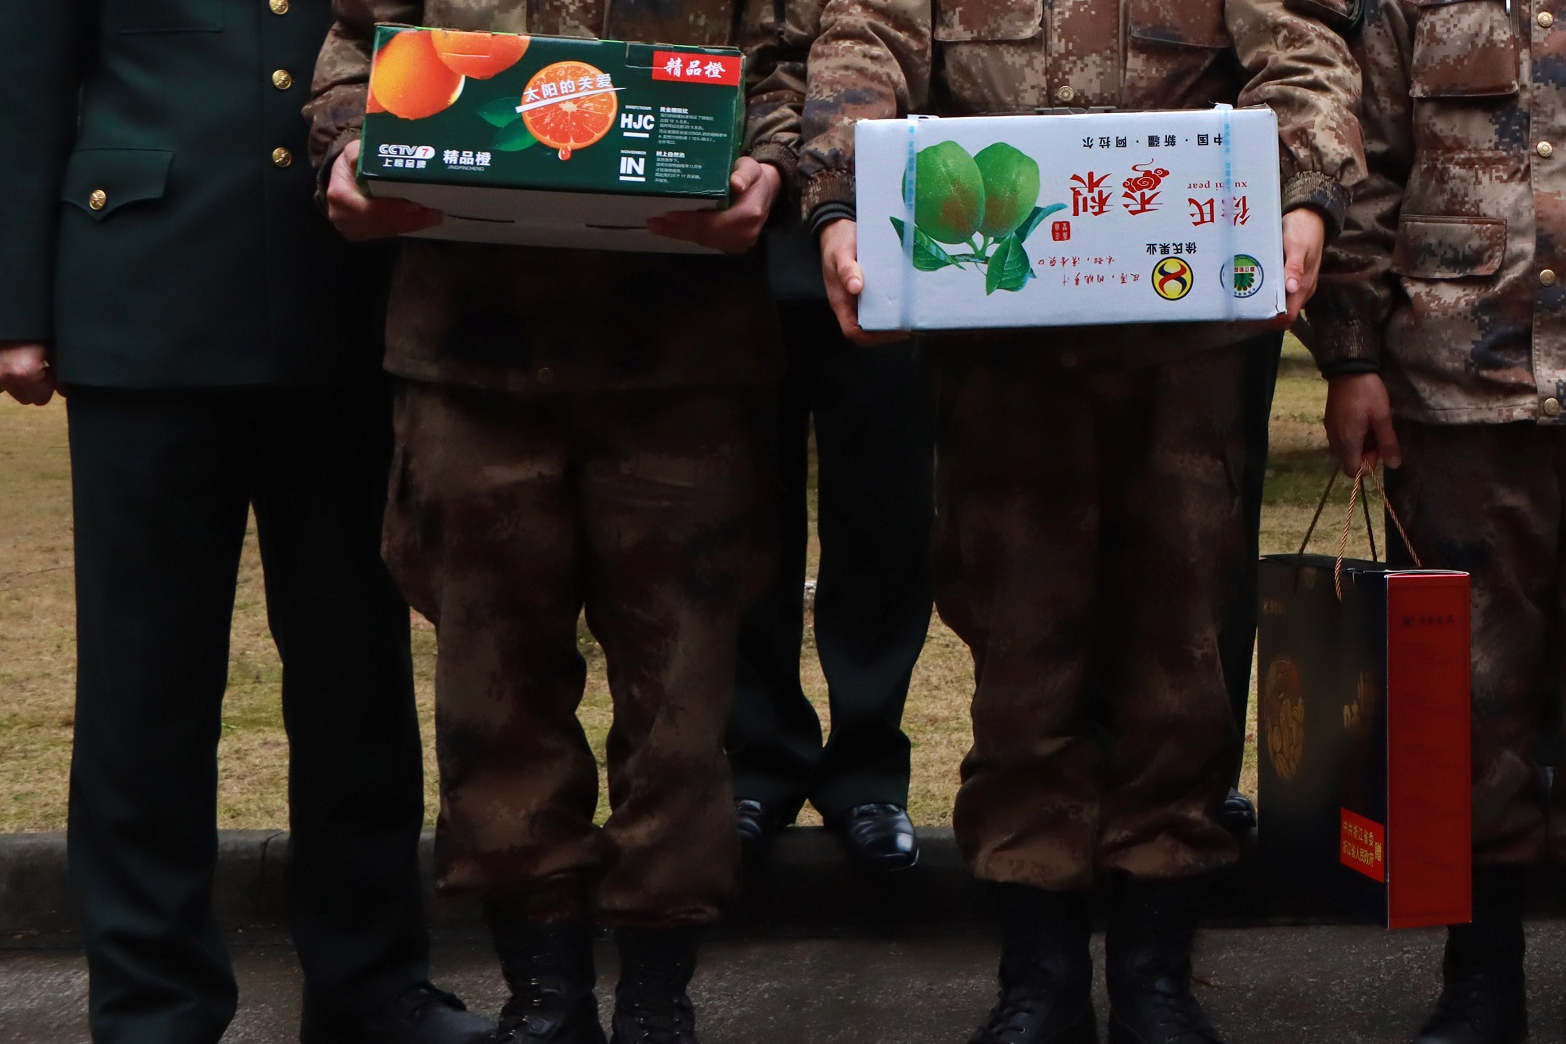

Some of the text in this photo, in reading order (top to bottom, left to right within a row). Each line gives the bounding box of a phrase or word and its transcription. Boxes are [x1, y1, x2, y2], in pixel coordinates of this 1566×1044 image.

[664, 57, 726, 78] 精品橙
[523, 73, 612, 103] 太阳的关爱
[620, 113, 655, 130] HJC
[443, 149, 491, 166] 精品橙
[619, 157, 645, 175] IN
[1187, 180, 1211, 189] pear
[1145, 241, 1197, 256] 徐氏果业
